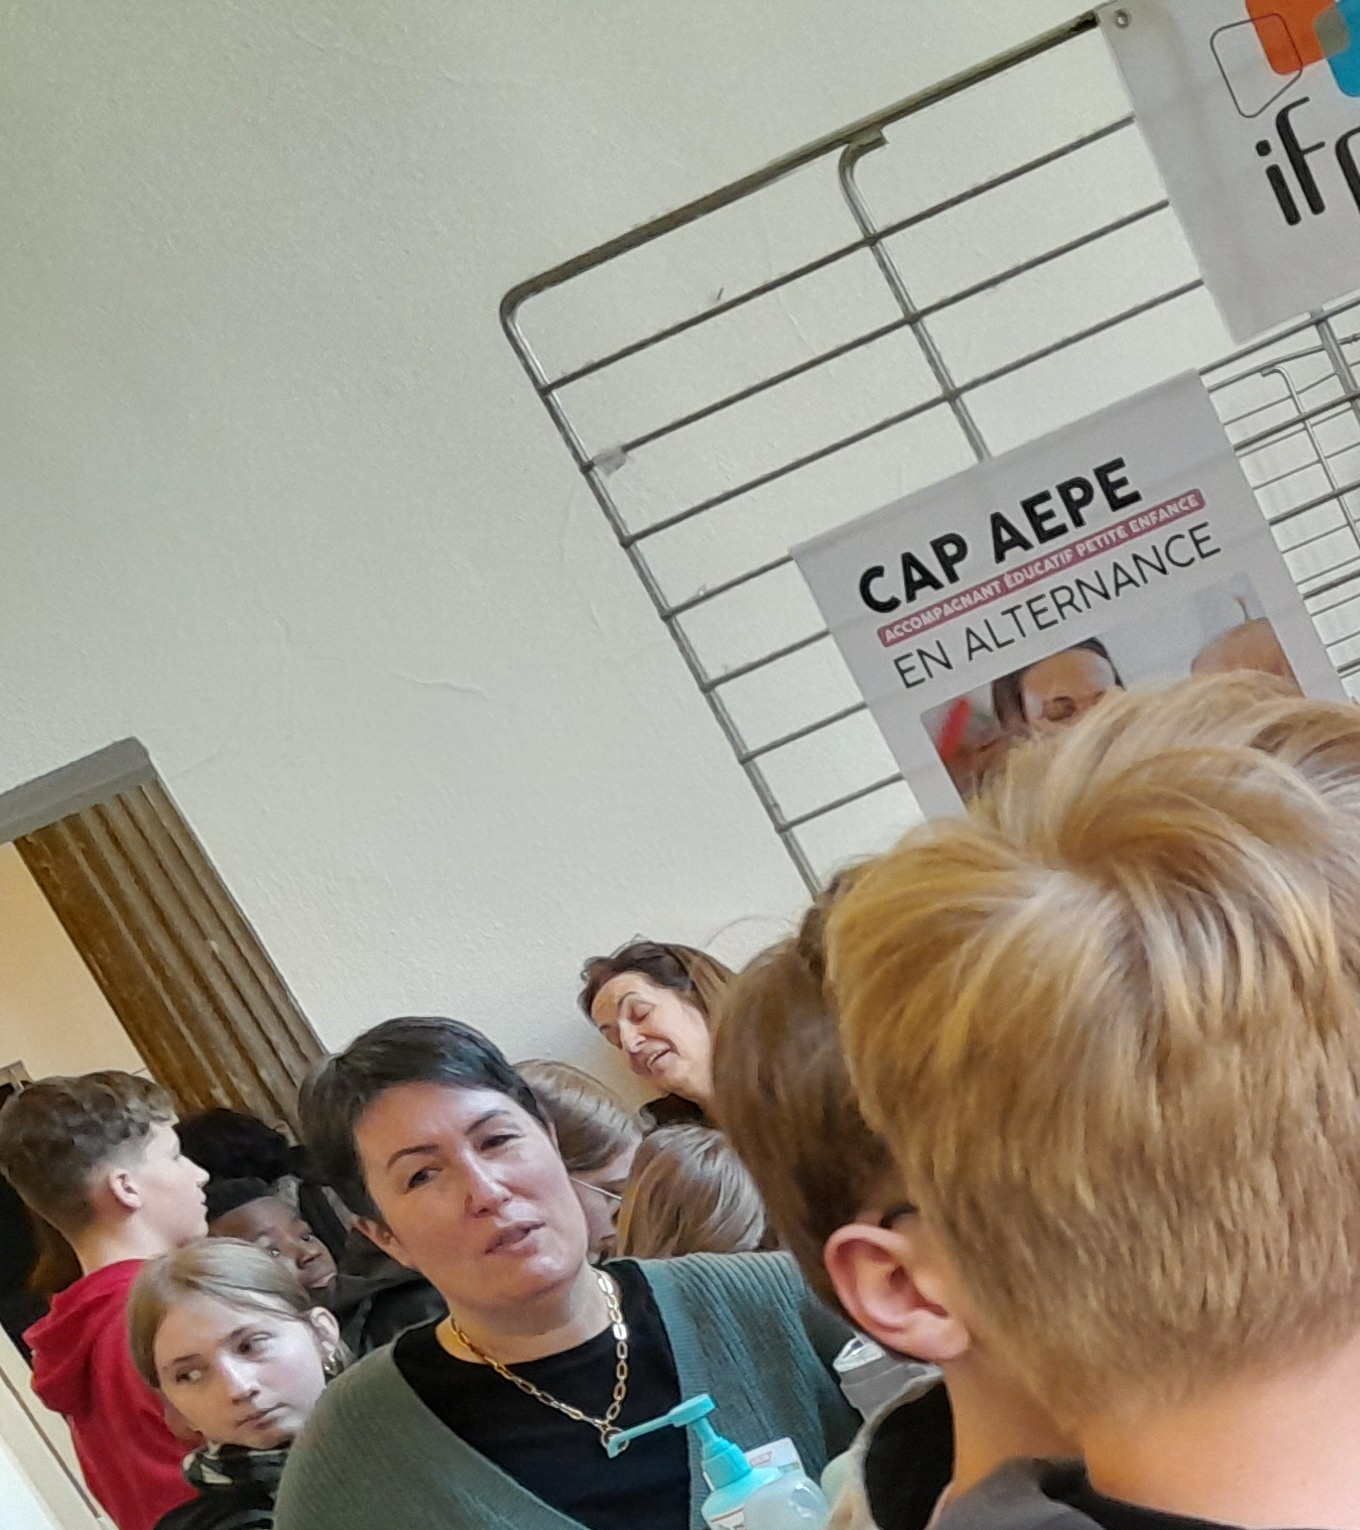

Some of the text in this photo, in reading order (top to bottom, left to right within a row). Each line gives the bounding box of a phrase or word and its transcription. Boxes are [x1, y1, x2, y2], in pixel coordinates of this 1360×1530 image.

[858, 457, 1143, 614] CAP AEPE
[883, 493, 1200, 643] ACCOMPAGNANT ÉDUCATIF PETITE ENFANCE
[895, 521, 1221, 690] EN ALTERNANCE
